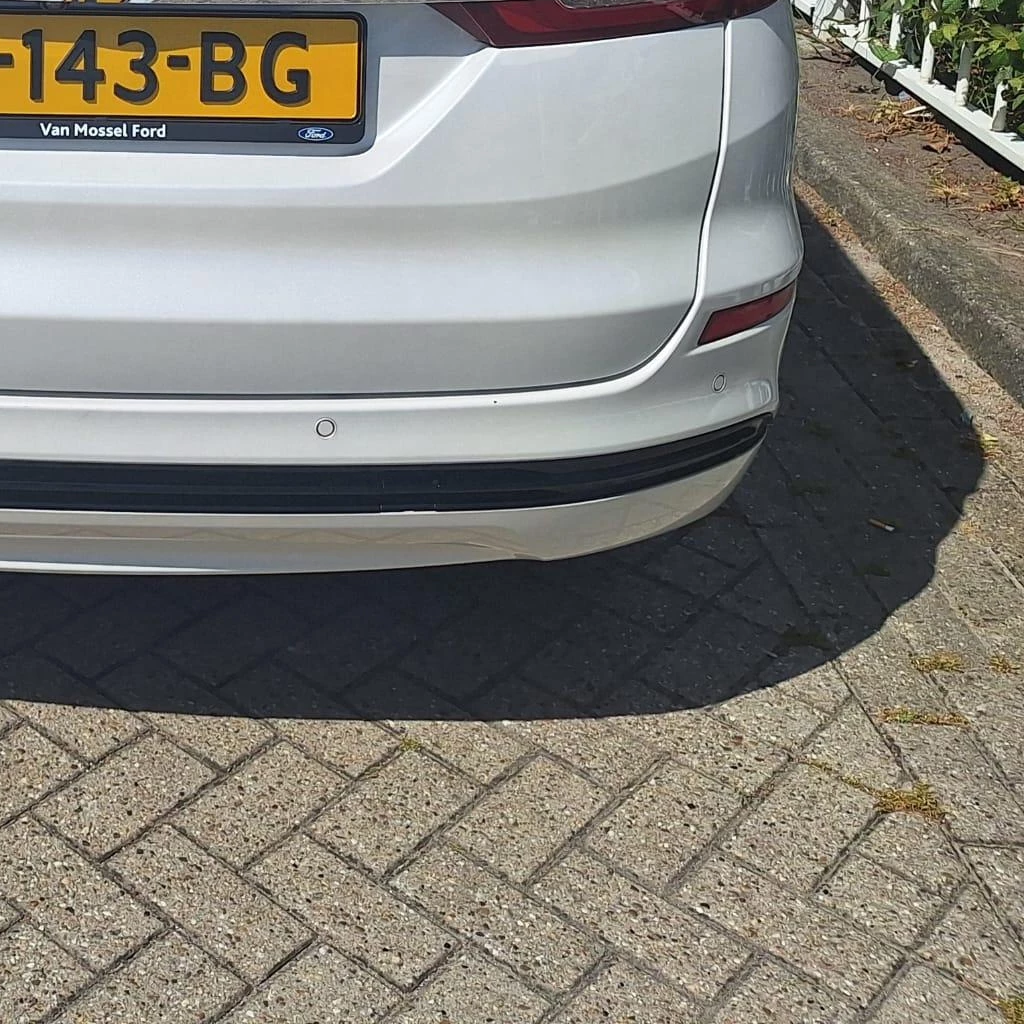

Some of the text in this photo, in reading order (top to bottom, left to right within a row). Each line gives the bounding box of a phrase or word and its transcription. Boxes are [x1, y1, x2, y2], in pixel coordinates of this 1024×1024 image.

[40, 122, 167, 139] Van Mossel Ford
